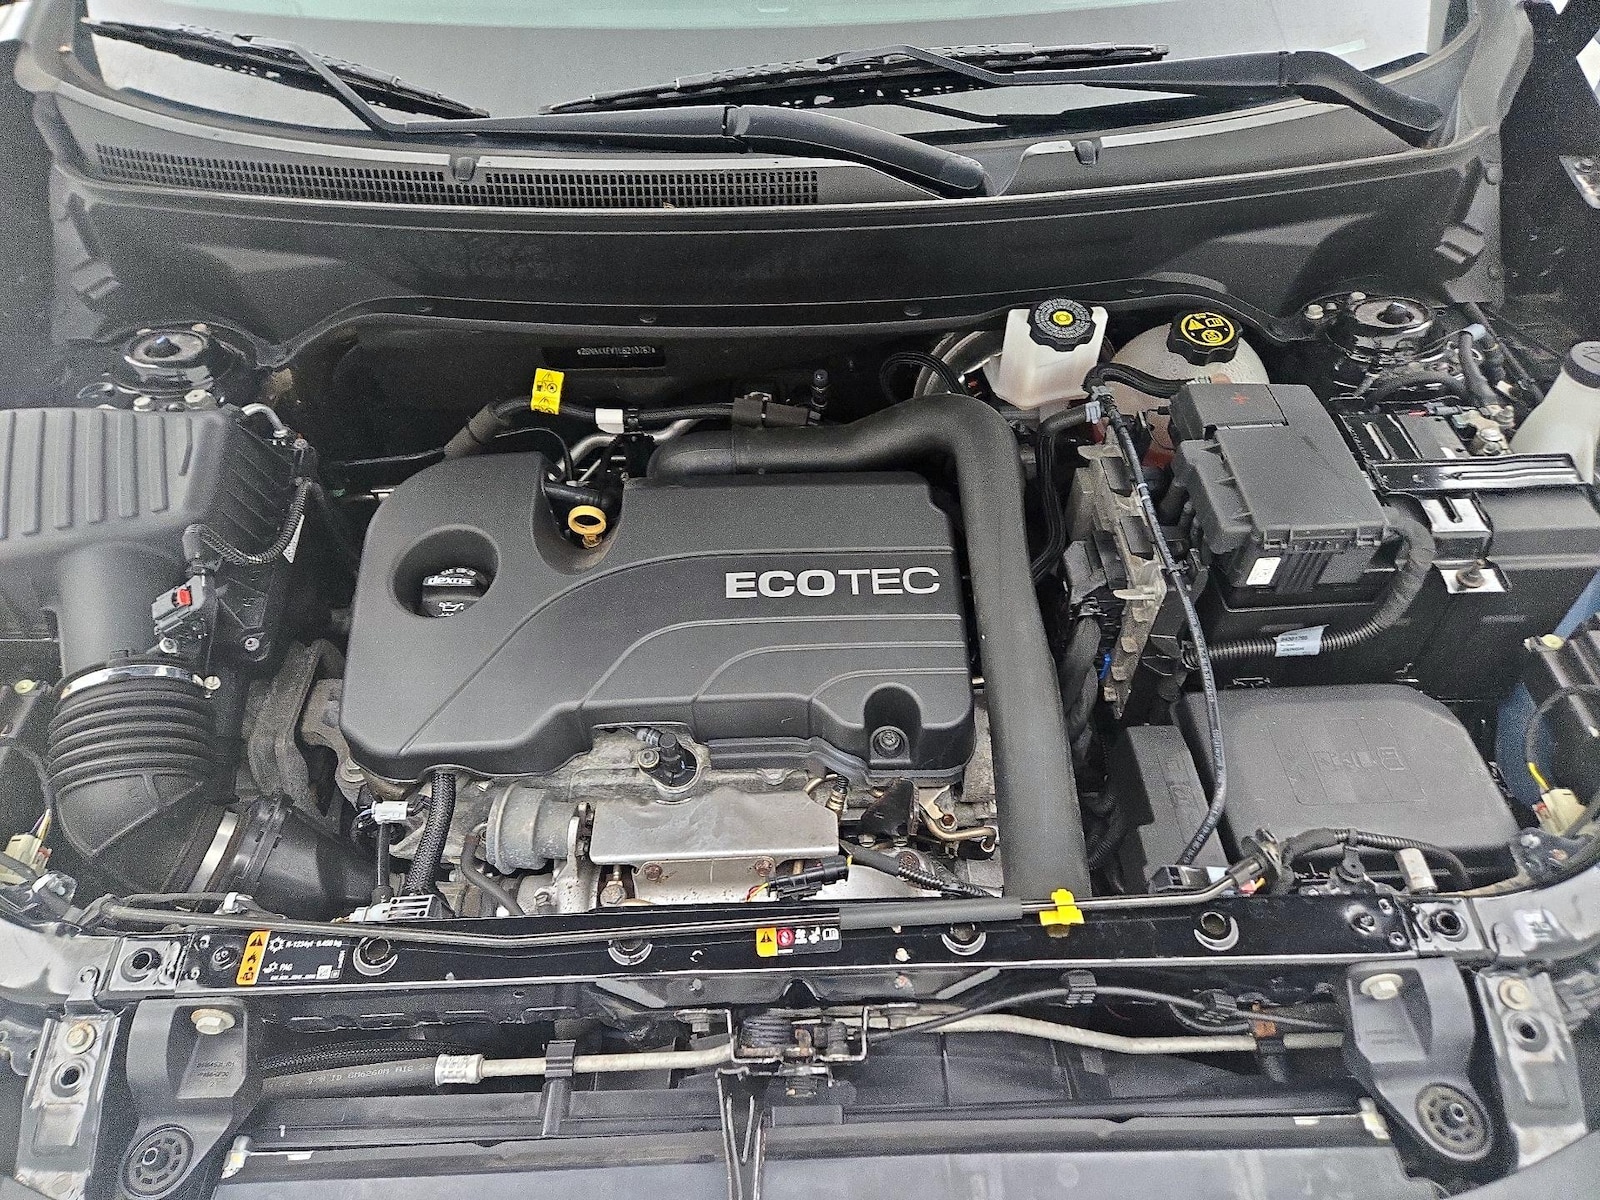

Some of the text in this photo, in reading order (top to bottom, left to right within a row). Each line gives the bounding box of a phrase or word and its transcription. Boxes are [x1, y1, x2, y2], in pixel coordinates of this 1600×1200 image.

[427, 575, 473, 585] dexos
[725, 566, 940, 598] ECOTEC
[279, 963, 294, 972] PAG
